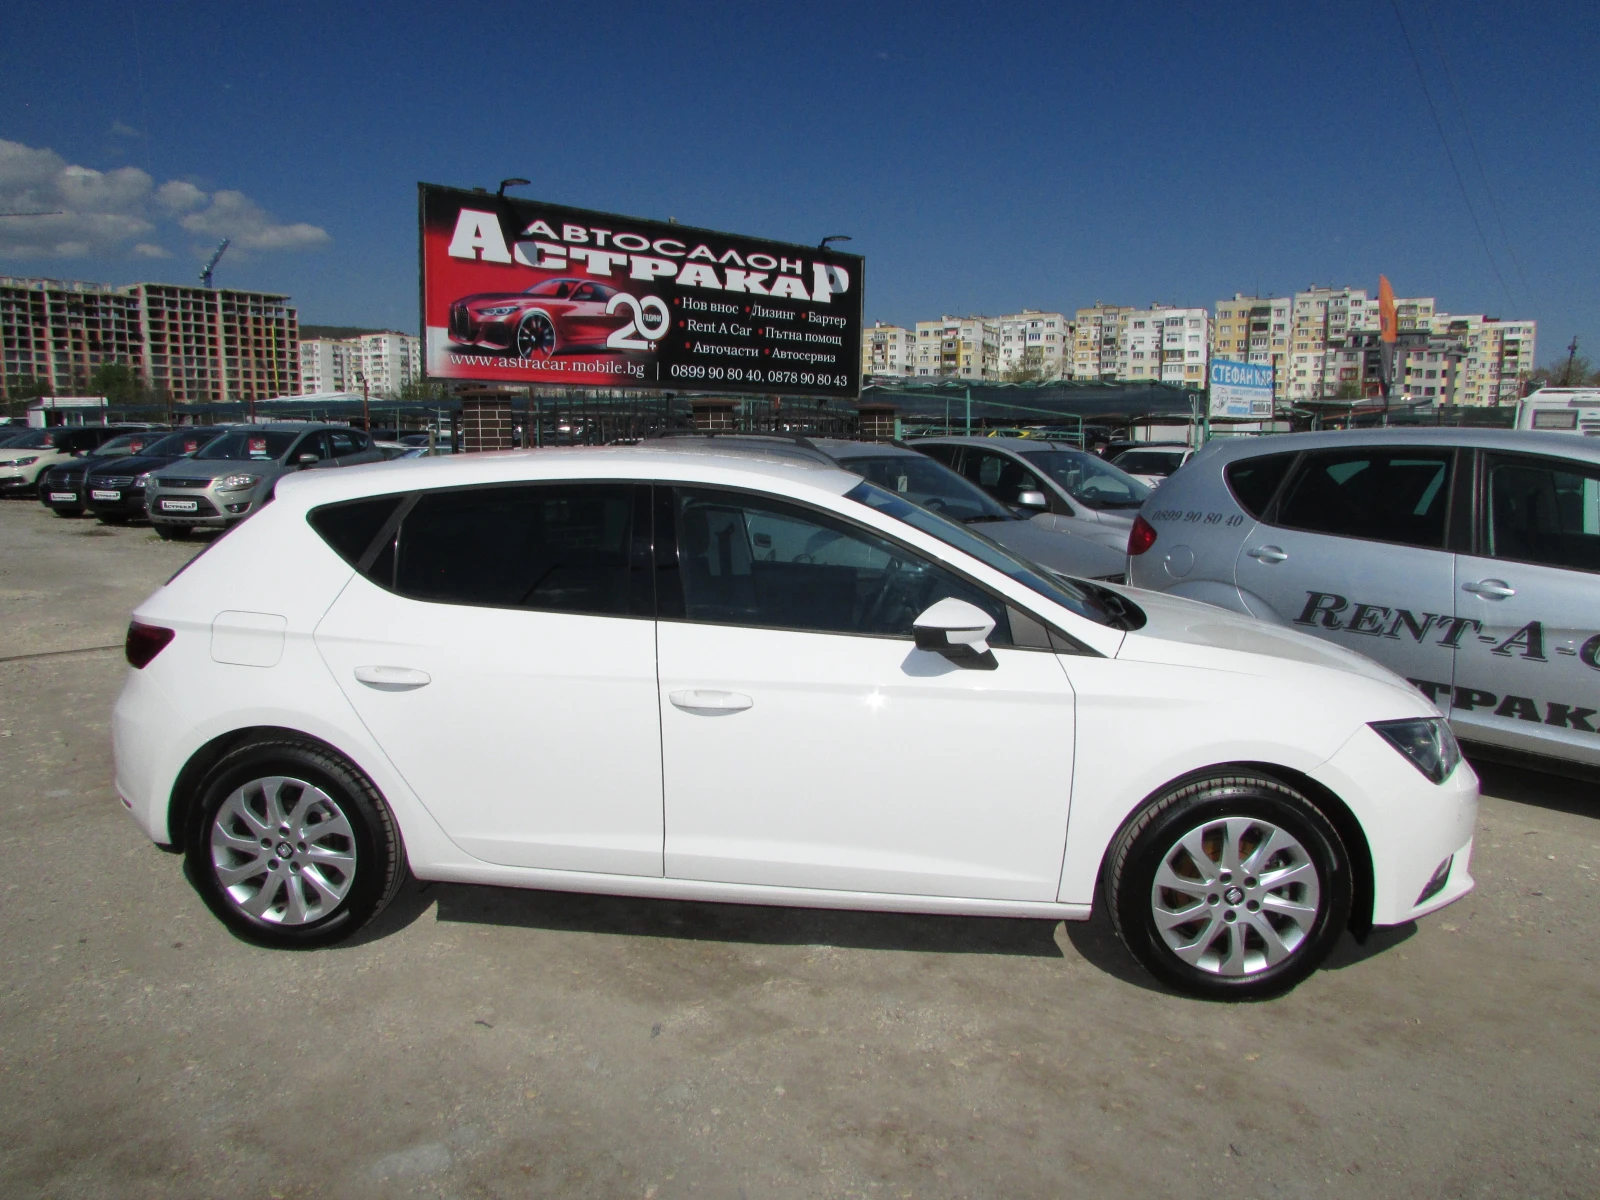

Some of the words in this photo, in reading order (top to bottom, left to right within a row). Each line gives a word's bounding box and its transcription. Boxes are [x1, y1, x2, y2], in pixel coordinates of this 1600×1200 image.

[521, 220, 803, 275] АВТОСАЛОН
[682, 297, 708, 311] Нов
[710, 302, 739, 315] внос
[752, 304, 796, 321] Лизинг
[687, 319, 717, 334] Rent
[718, 322, 728, 335] A
[730, 323, 752, 337] Car
[808, 311, 847, 329] Бартер
[765, 326, 802, 342] Пътна
[804, 333, 843, 347] помощ
[693, 341, 759, 358] Авточасти
[771, 347, 836, 364] Автосервиз
[450, 353, 645, 378] www.astracar.mobile.bg
[670, 364, 706, 379] 0899
[708, 366, 724, 380] 90
[727, 367, 743, 381] 80
[767, 370, 798, 384] 0878
[800, 372, 815, 385] 90
[817, 374, 831, 387] 80
[833, 375, 848, 387] 43
[1211, 364, 1254, 386] СТЕФАН
[1254, 369, 1272, 387] КАР
[1151, 510, 1183, 521] 0899
[1184, 510, 1202, 522] 90
[1203, 512, 1222, 525] 80
[1224, 514, 1244, 527] 40
